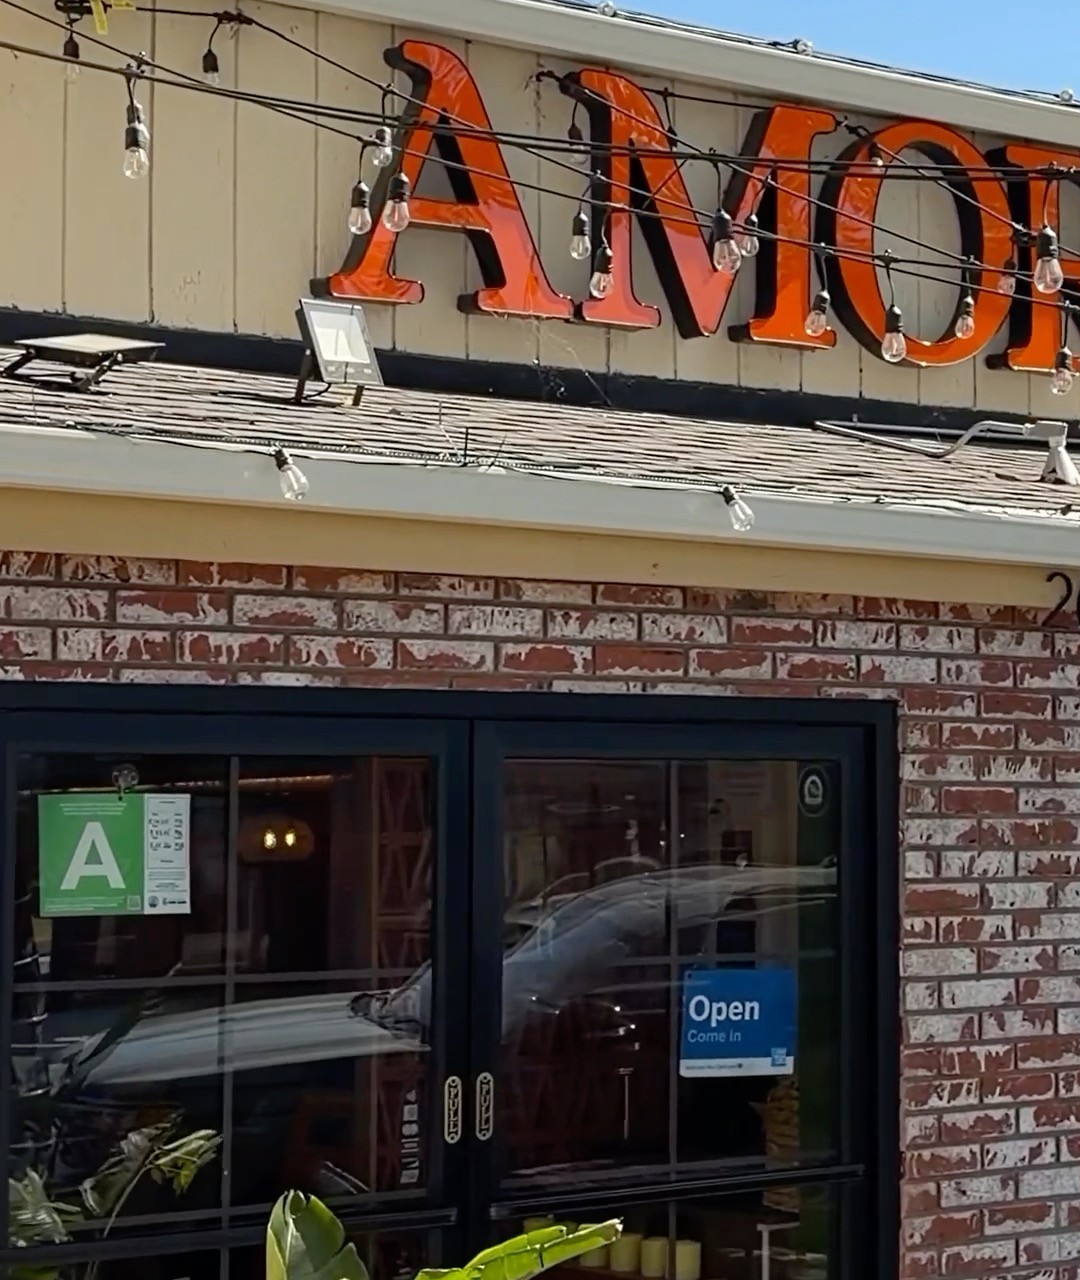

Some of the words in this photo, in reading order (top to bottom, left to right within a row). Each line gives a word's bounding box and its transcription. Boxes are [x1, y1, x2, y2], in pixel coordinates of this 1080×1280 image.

[60, 821, 126, 890] A
[688, 994, 761, 1028] Open
[687, 1029, 726, 1043] Come
[448, 1087, 459, 1133] PULL
[481, 1084, 490, 1129] PULL
